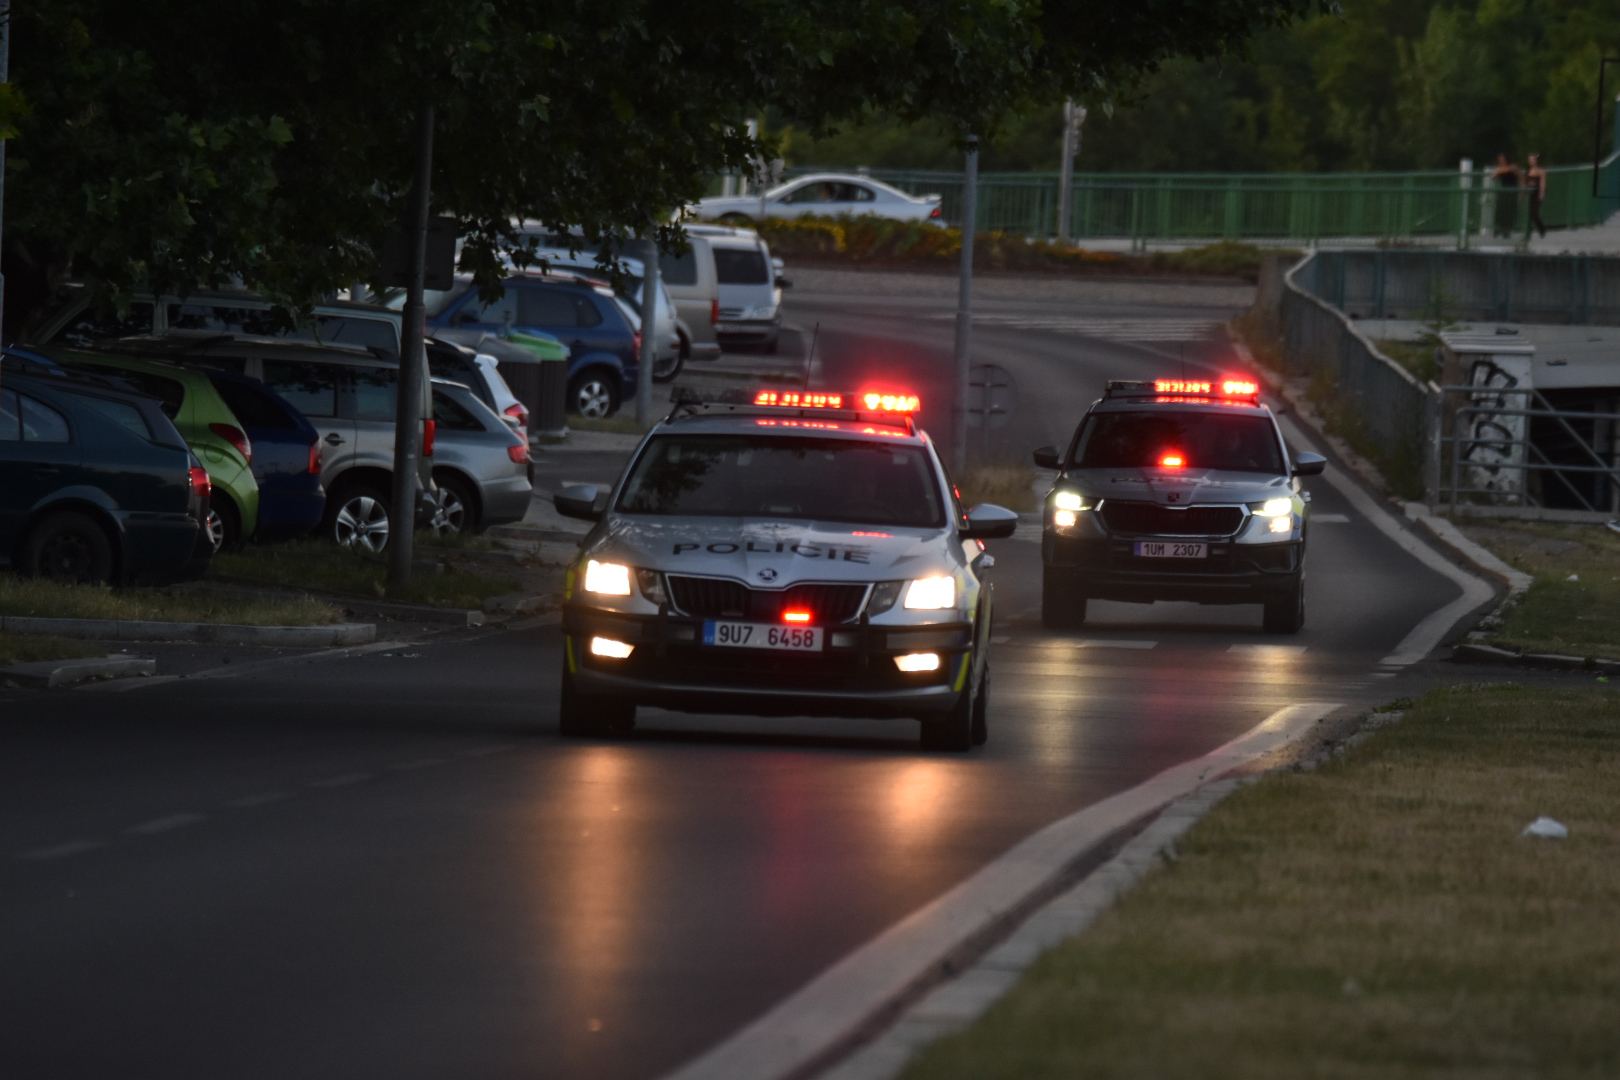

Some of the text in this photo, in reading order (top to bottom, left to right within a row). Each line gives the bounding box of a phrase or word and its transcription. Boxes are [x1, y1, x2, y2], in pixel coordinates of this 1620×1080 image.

[672, 541, 871, 565] POLICIE
[1172, 544, 1202, 557] 2307
[719, 624, 754, 645] 9U7
[767, 627, 814, 648] 6458
